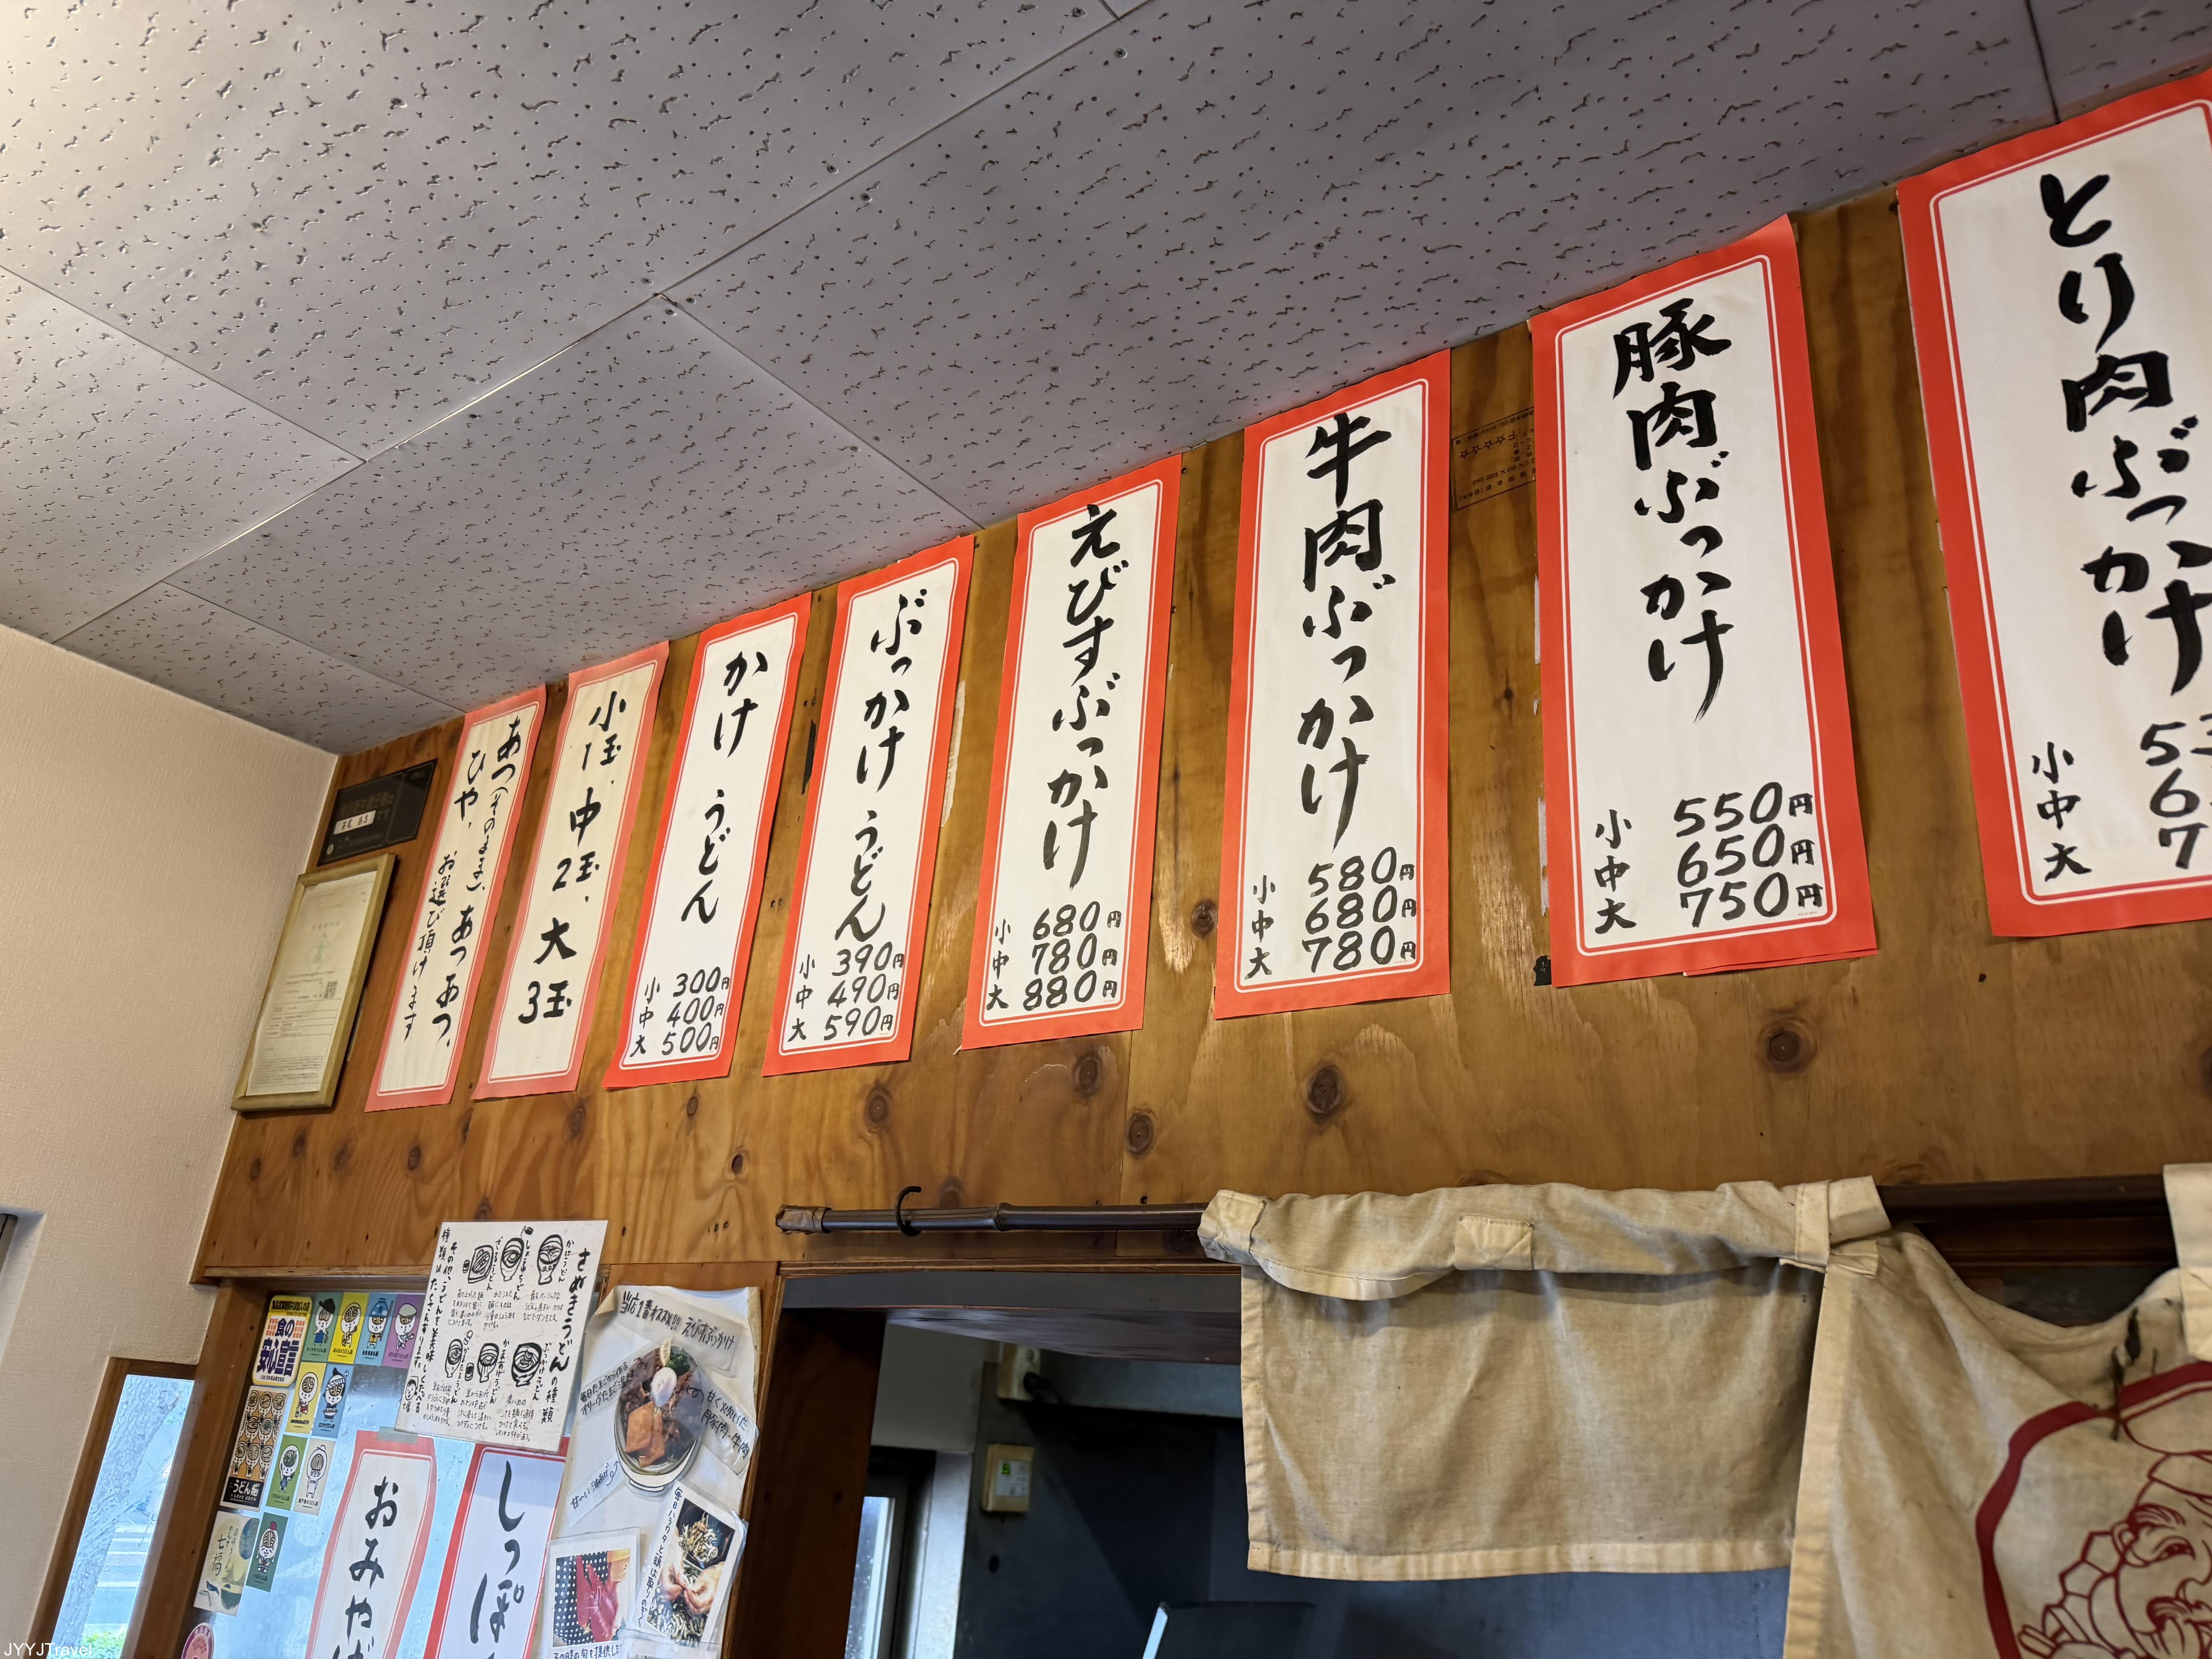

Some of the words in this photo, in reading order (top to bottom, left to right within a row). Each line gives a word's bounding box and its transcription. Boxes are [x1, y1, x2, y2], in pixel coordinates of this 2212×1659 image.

[2040, 174, 2212, 696] とり肉ぶっかけ
[1613, 298, 1734, 722] 豚肉ぶっかけ
[1297, 412, 1396, 852] 牛肉ぶっかけ
[714, 651, 768, 757] かけ
[857, 589, 927, 792] ぶっかけ
[1042, 503, 1128, 889] えびすぶっかけ
[2032, 742, 2074, 784] 小
[1595, 809, 1632, 849] 小
[1674, 782, 1812, 837] 550円
[2037, 790, 2081, 830] 中
[2150, 765, 2212, 817] 6
[681, 790, 730, 924] うどん
[835, 811, 885, 942] うどん
[1253, 875, 1275, 904] 小
[1308, 845, 1415, 896] 580円
[1594, 855, 1630, 892] 中
[1678, 825, 1814, 886] 650円
[2044, 843, 2092, 882] 大
[995, 919, 1010, 945] 小
[1033, 902, 1121, 940] 680円
[1252, 910, 1274, 942] 中
[1305, 885, 1416, 934] 680円
[1595, 898, 1637, 934] 大
[1680, 872, 1823, 927] 750円
[404, 851, 456, 1041] お選び頂けます
[800, 954, 815, 979] 小
[832, 942, 904, 976] 390円
[993, 951, 1009, 979] 中
[1032, 934, 1117, 975] 780円
[1247, 947, 1271, 978] 大
[1302, 926, 1416, 973] 780円
[640, 1007, 654, 1029] 中
[667, 996, 724, 1027] 400円
[645, 977, 660, 1004] 小
[673, 967, 729, 998] 300円
[796, 985, 813, 1009] 中
[828, 974, 899, 1008] 490円
[986, 984, 1008, 1010] 大
[1023, 970, 1117, 1011] 880円
[630, 1035, 646, 1057] 大
[662, 1022, 719, 1055] 500円
[788, 1018, 806, 1042] 大
[824, 1006, 893, 1041] 590円
[487, 1237, 503, 1290] ざるうどん
[558, 1240, 575, 1282] かけうどん
[275, 1318, 295, 1338] 食の
[542, 1248, 591, 1423] さぬきうどんの種類
[682, 1317, 734, 1350] えびすぶっかけ
[256, 1337, 300, 1377] 安心宣言
[532, 1342, 552, 1400] ぶっかけうどん
[707, 1390, 747, 1431] 甘く炊いた
[470, 1461, 524, 1659] しっぽ
